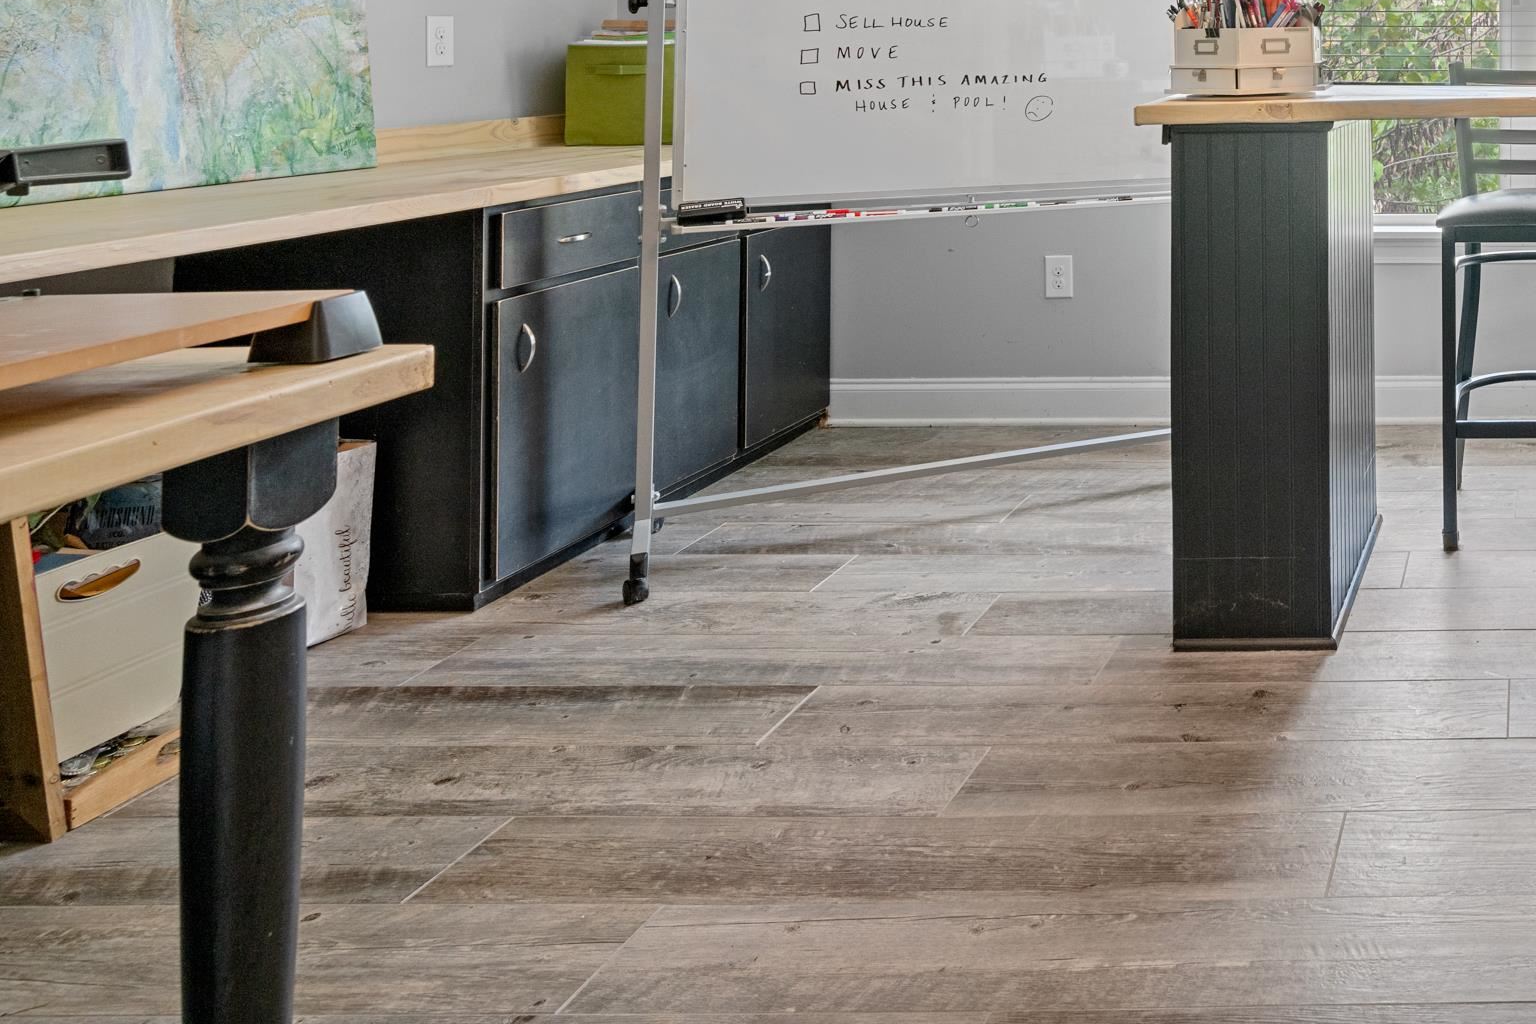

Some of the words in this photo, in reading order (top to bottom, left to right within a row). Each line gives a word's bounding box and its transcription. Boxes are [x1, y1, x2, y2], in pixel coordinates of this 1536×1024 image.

[834, 13, 885, 31] SELL
[890, 16, 950, 31] HOUSE
[836, 44, 900, 61] MOVE
[833, 77, 887, 93] MISS
[897, 74, 947, 89] THIS
[960, 72, 1049, 89] AMAZING
[855, 96, 912, 113] HOUSE
[952, 95, 1008, 112] POOL!
[335, 524, 358, 593] beautiful
